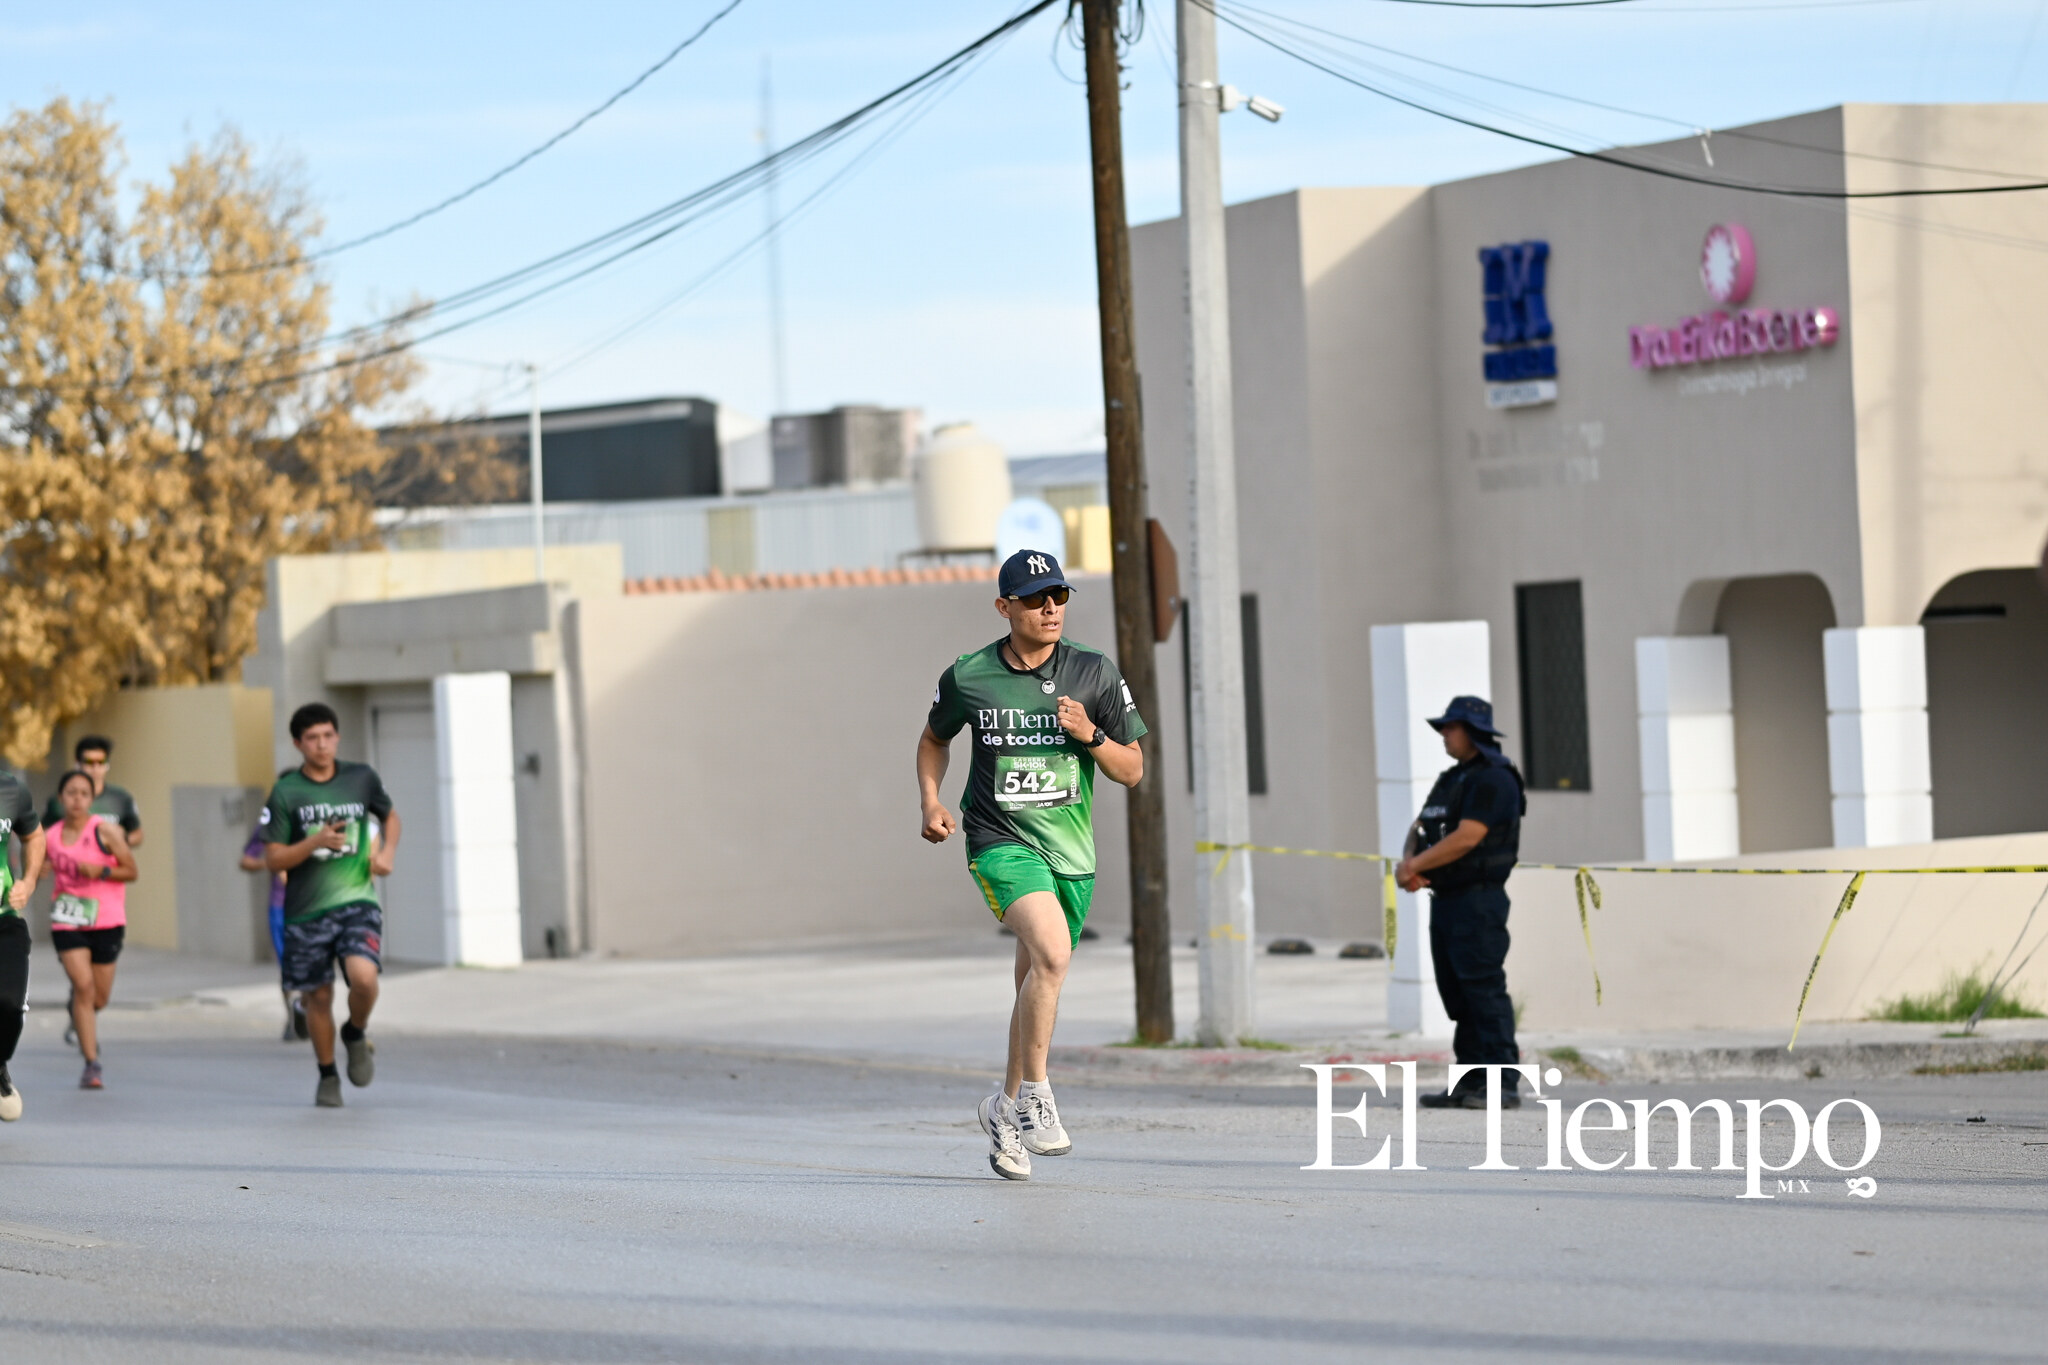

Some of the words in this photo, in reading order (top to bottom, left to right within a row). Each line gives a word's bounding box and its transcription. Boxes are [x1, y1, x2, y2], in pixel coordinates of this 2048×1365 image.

[977, 708, 999, 730] El
[1001, 708, 1064, 733] Tiem
[982, 732, 1003, 746] de
[1005, 732, 1066, 746] todos
[1004, 770, 1057, 794] 542
